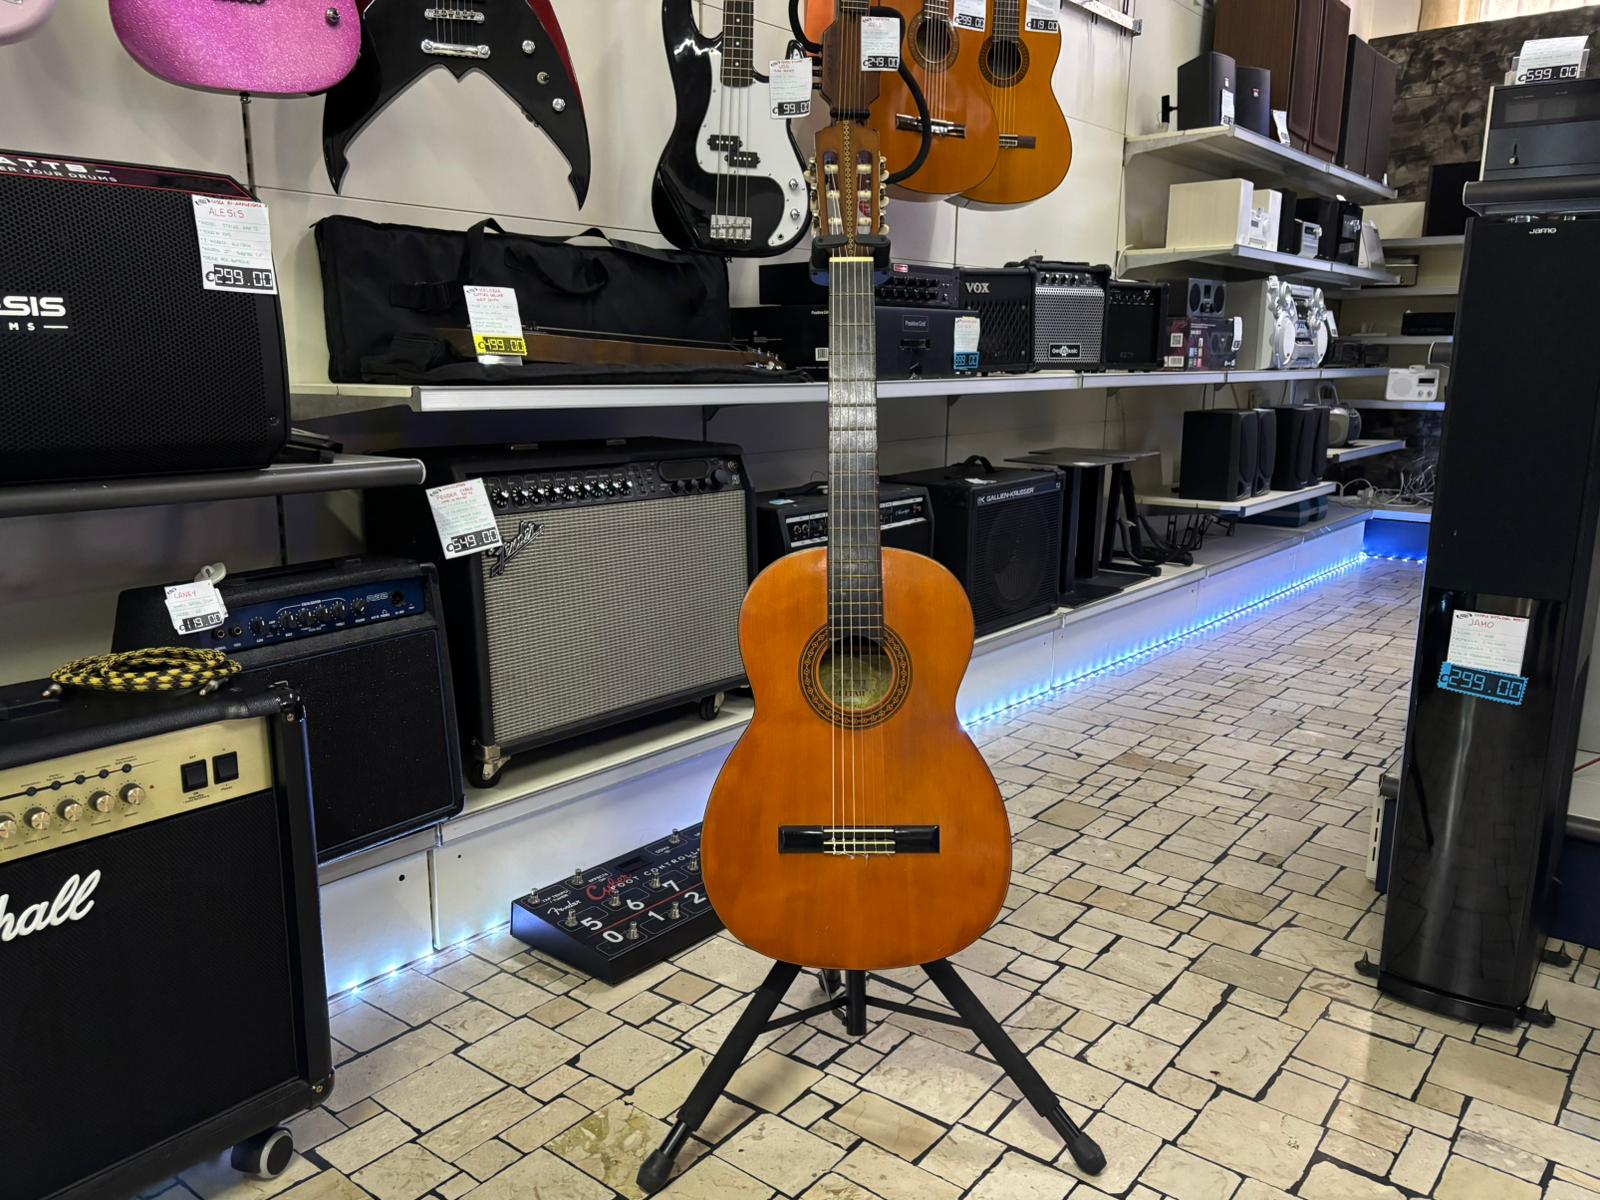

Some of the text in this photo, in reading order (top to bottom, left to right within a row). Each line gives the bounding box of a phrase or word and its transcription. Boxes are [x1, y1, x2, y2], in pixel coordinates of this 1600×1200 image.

[68, 172, 118, 183] DRUMS
[965, 282, 990, 293] VOX
[662, 880, 680, 892] 7
[684, 891, 706, 905] 2
[547, 899, 582, 916] Fender
[626, 899, 645, 911] 6
[648, 910, 665, 922] 1
[580, 917, 603, 931] 5
[602, 930, 624, 943] 0
